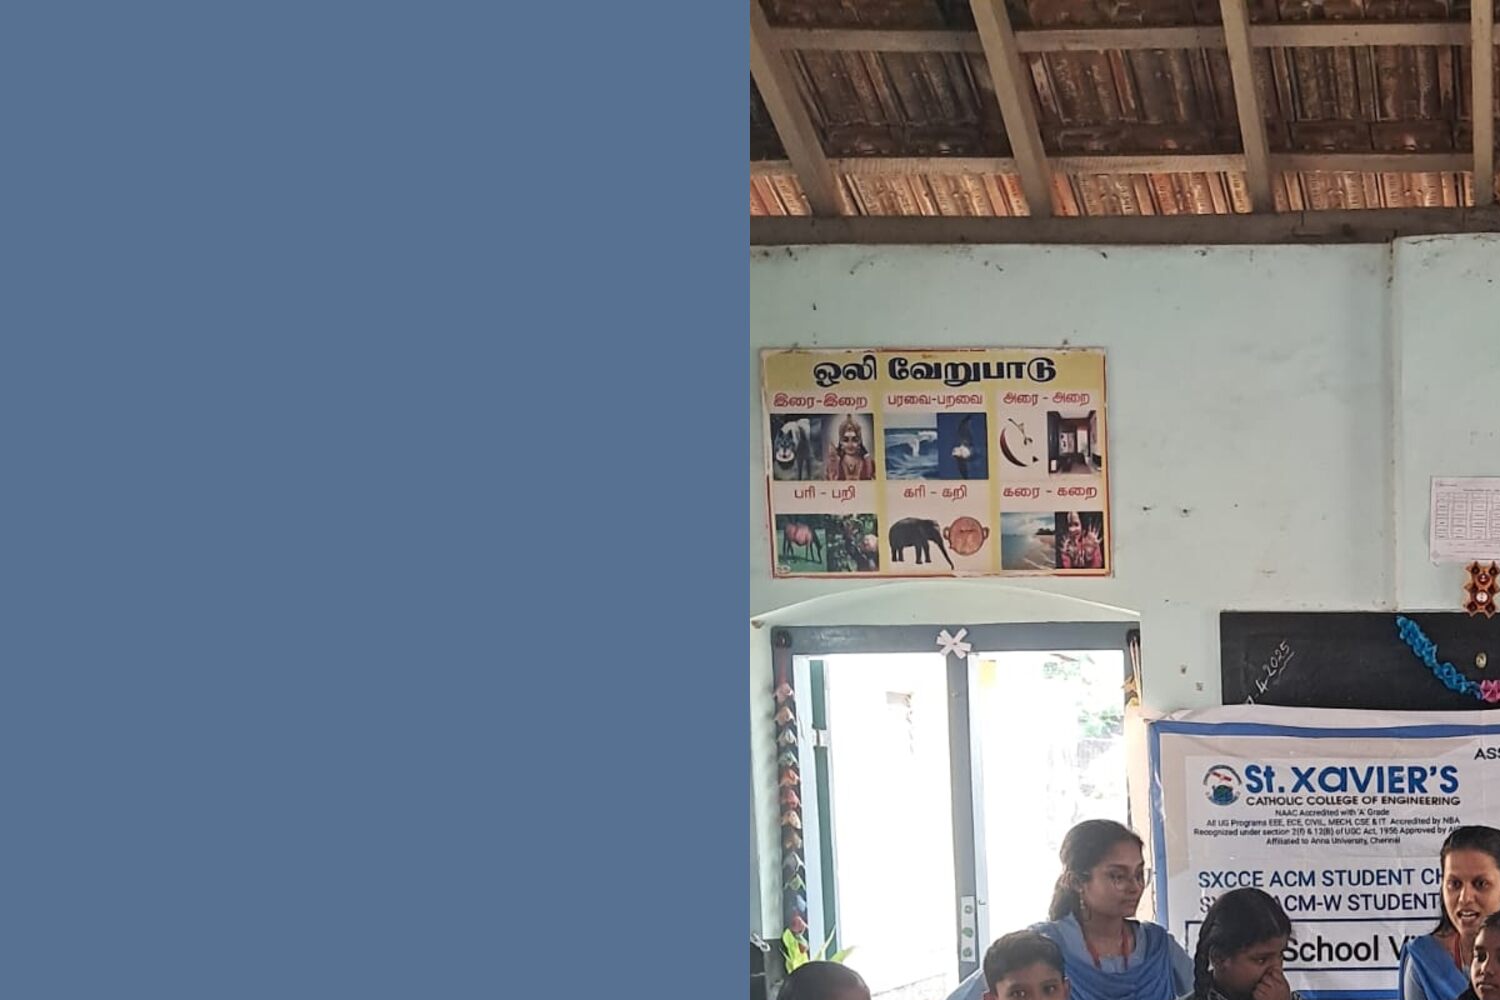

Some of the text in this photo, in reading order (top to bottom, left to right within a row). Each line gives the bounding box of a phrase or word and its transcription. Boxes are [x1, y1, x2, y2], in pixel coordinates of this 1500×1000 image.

[814, 354, 1056, 388] ஒலி வேறுபாடு
[1246, 795, 1461, 806] CATHOLIC COLLEGE OF ENGINEERING
[1367, 808, 1390, 816] Grade
[1231, 819, 1267, 828] Programs
[1194, 828, 1238, 837] Recognized
[1240, 828, 1261, 836] under
[1198, 871, 1264, 888] SXCCE
[1269, 870, 1315, 887] ACM
[1322, 868, 1416, 887] STUDENT
[1347, 893, 1440, 911] STUDENT
[1282, 935, 1378, 962] School
